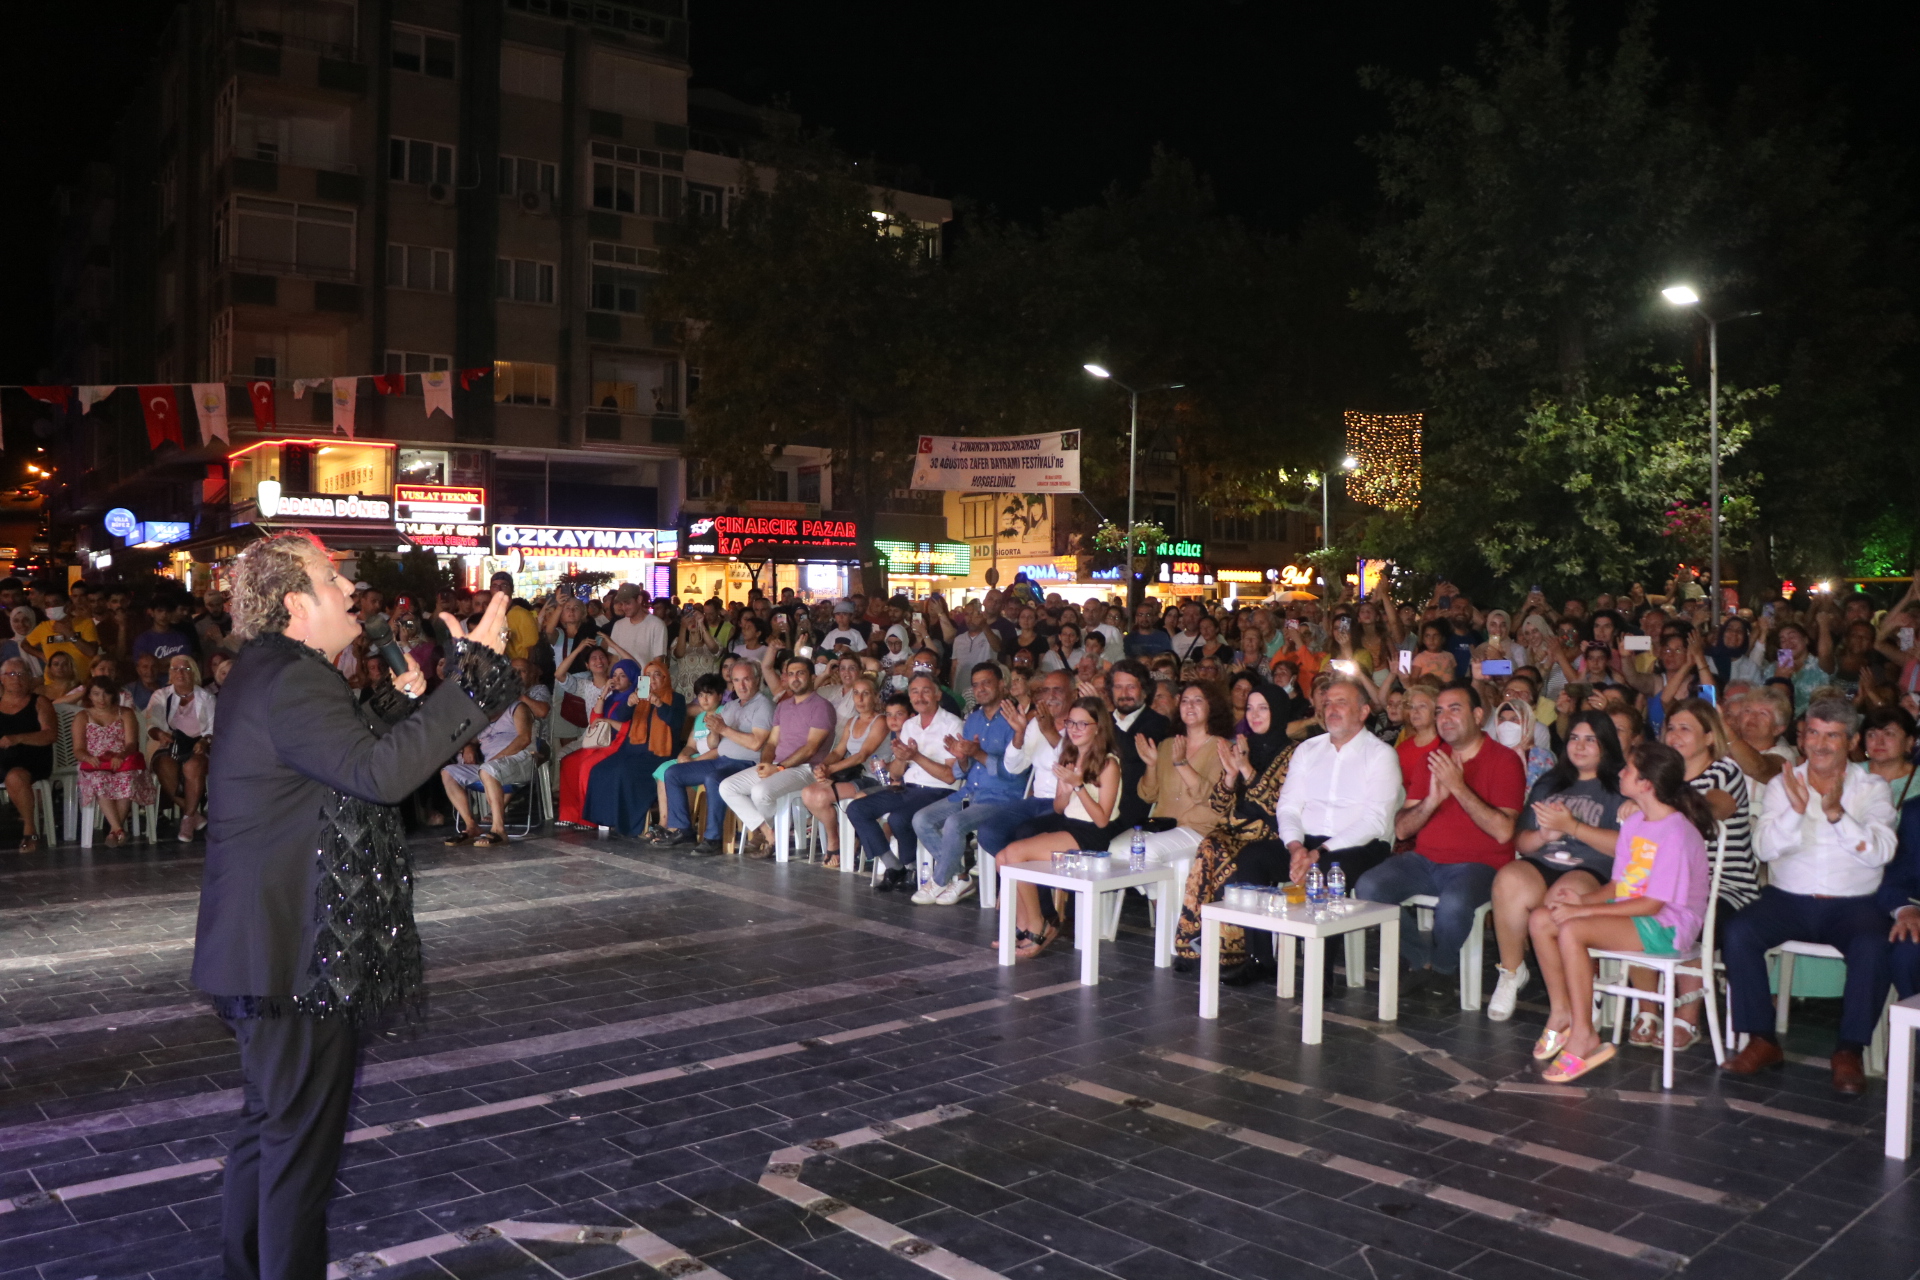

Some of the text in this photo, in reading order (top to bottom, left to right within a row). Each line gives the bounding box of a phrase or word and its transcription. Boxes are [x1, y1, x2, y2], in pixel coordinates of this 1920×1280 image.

[940, 455, 969, 469] AĞUSTOS
[969, 457, 990, 470] ZAFER
[990, 457, 1021, 470] BAYRAMI
[401, 491, 479, 502] VUSLAT TEKNİK
[277, 495, 390, 519] ADANA DÖNER
[406, 523, 455, 536] VUSLAT
[714, 516, 798, 538] ÇINARCIK
[802, 520, 857, 538] PAZAR
[496, 526, 655, 549] ÖZKAYMAK
[995, 548, 1021, 556] SİGORTA
[1175, 540, 1202, 558] GÜLCE
